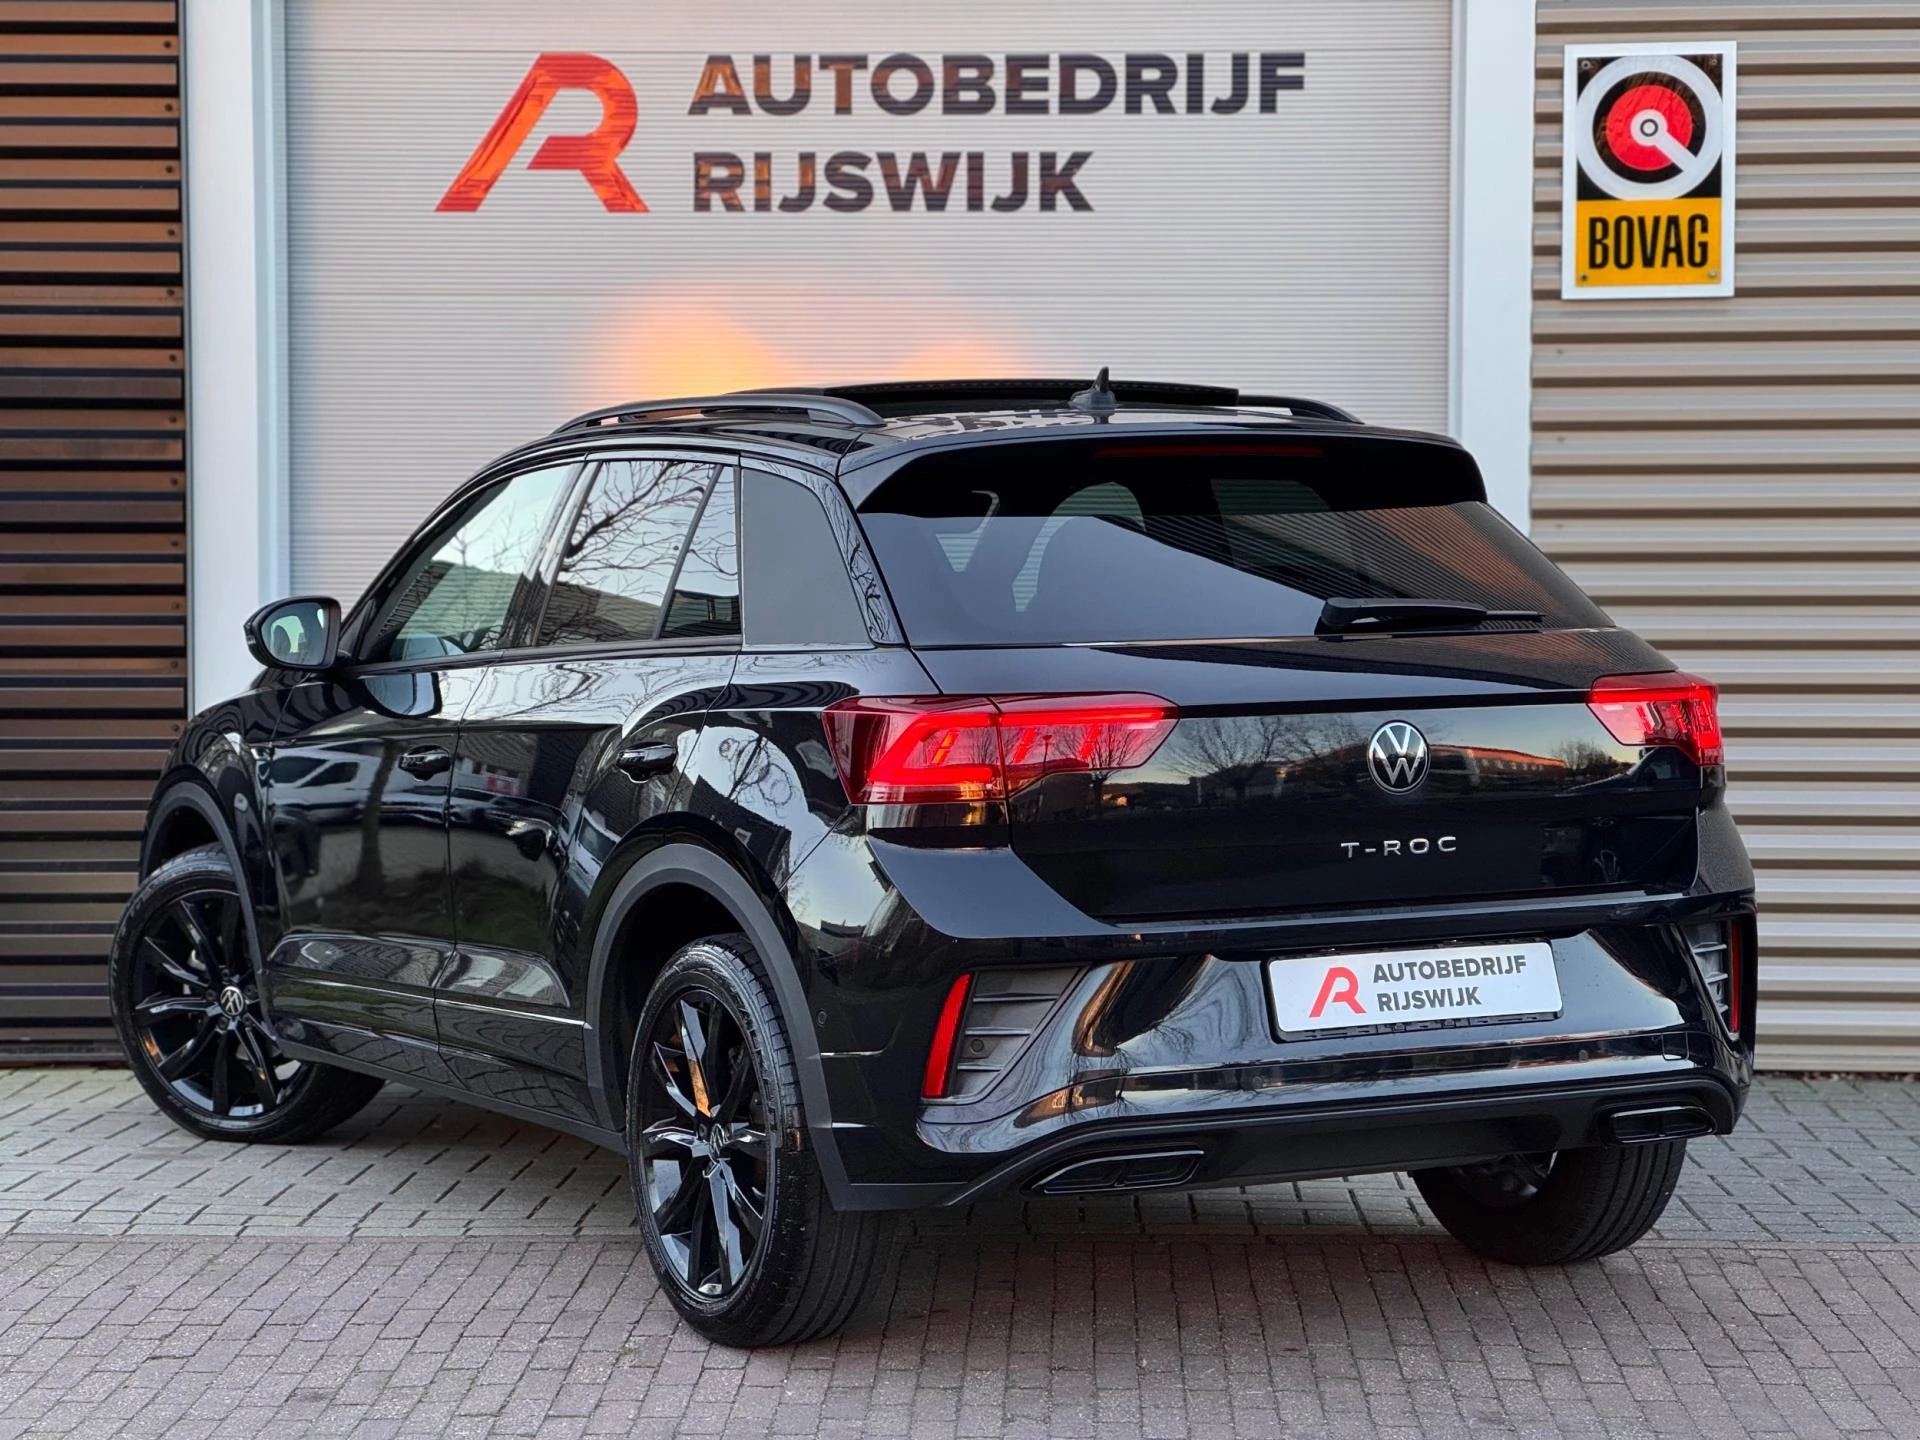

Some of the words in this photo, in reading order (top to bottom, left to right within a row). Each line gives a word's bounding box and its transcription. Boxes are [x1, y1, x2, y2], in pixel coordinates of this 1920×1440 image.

[686, 52, 1306, 115] AUTOBEDRIJF
[692, 151, 1095, 213] RIJSWIJK
[1588, 214, 1709, 269] BOVAG
[1340, 836, 1457, 859] T-ROC
[1373, 954, 1527, 984] AUTOBEDRIJF
[1376, 986, 1482, 1012] RIJSWIJK
